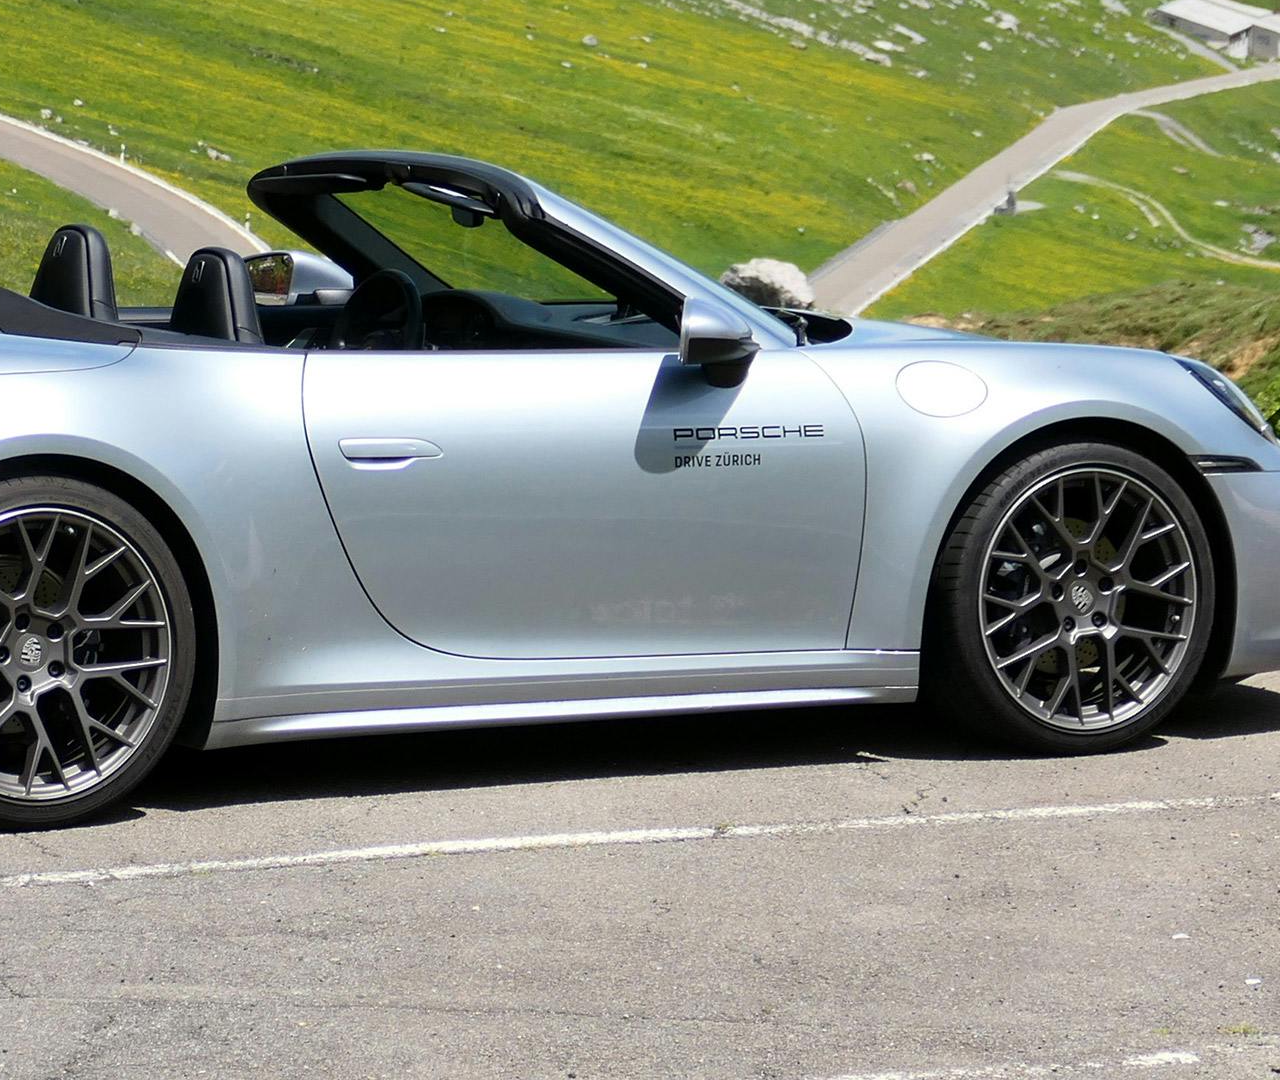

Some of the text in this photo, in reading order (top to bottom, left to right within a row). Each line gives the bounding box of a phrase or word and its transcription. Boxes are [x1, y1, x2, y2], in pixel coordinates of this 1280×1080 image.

[673, 424, 825, 442] PORSCHE
[674, 452, 761, 468] DRIVE ZÜRICH
